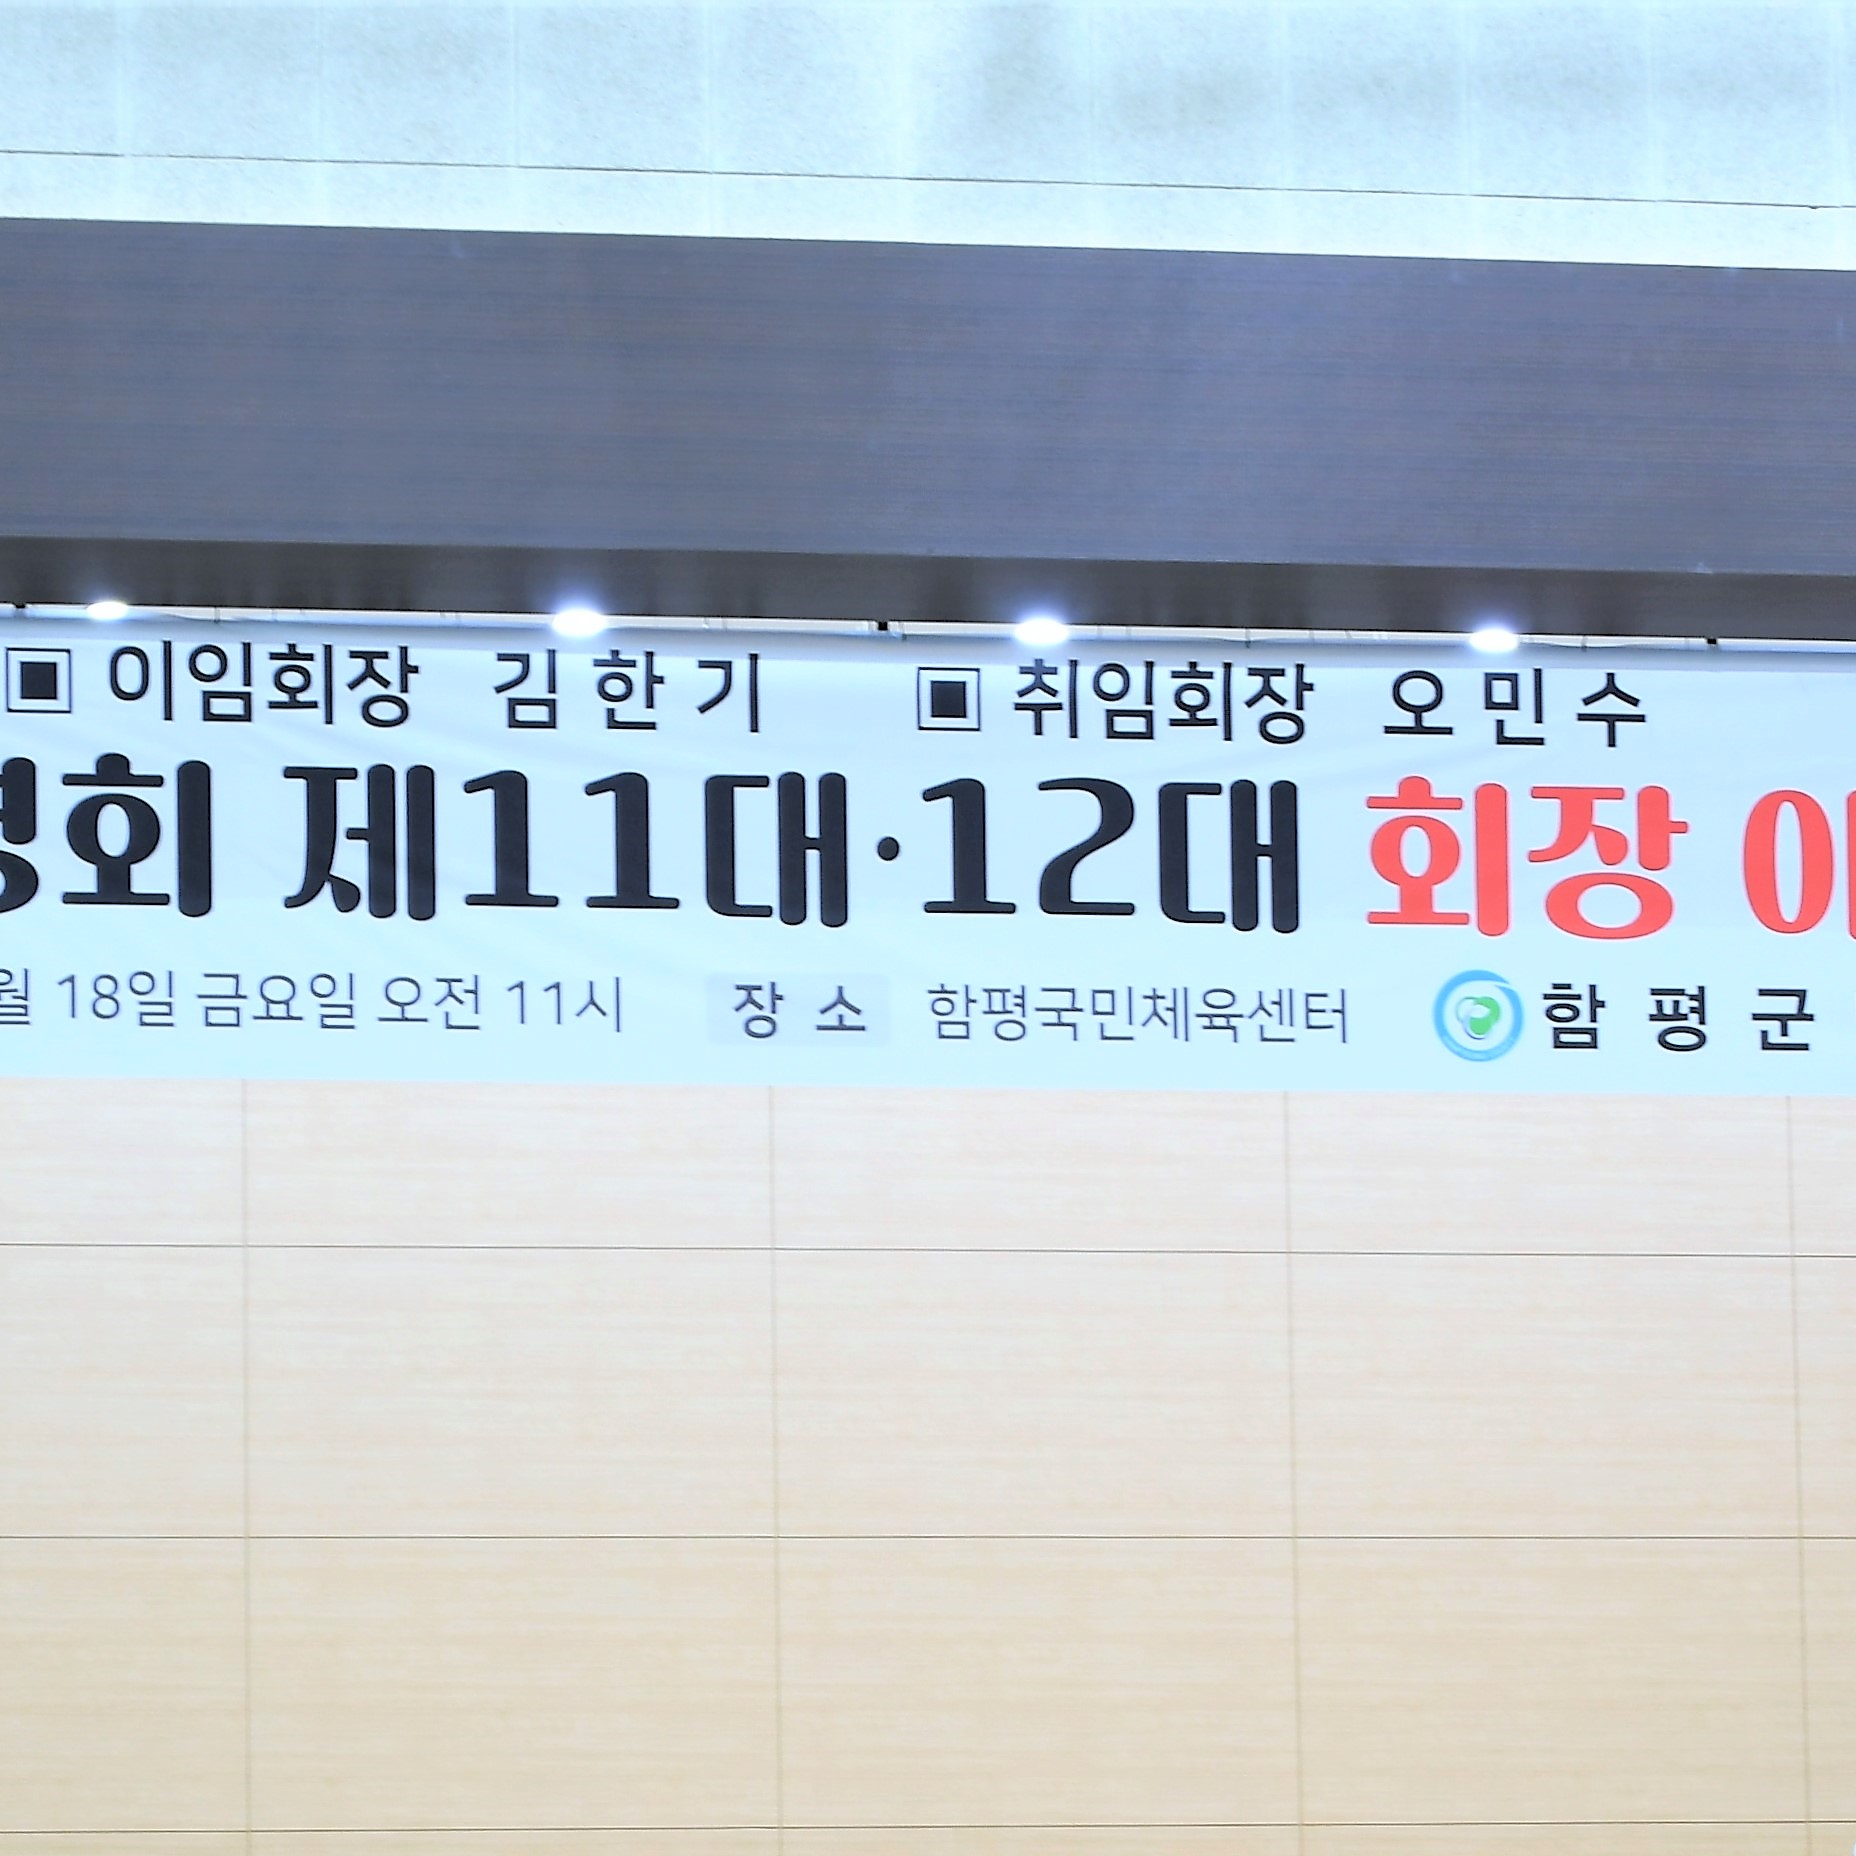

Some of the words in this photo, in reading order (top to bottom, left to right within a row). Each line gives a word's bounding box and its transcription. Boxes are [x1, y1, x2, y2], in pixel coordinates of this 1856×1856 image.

[109, 639, 421, 729] 이임회장
[1013, 658, 1316, 746] 취임회장
[1383, 667, 1648, 748] 오민수
[1367, 775, 1690, 940] 회장
[58, 970, 175, 1028] 18일
[197, 972, 357, 1031] 금요일
[377, 974, 481, 1032] 오전
[507, 976, 623, 1034] 11시
[927, 983, 1348, 1045] 함평국민체육센터
